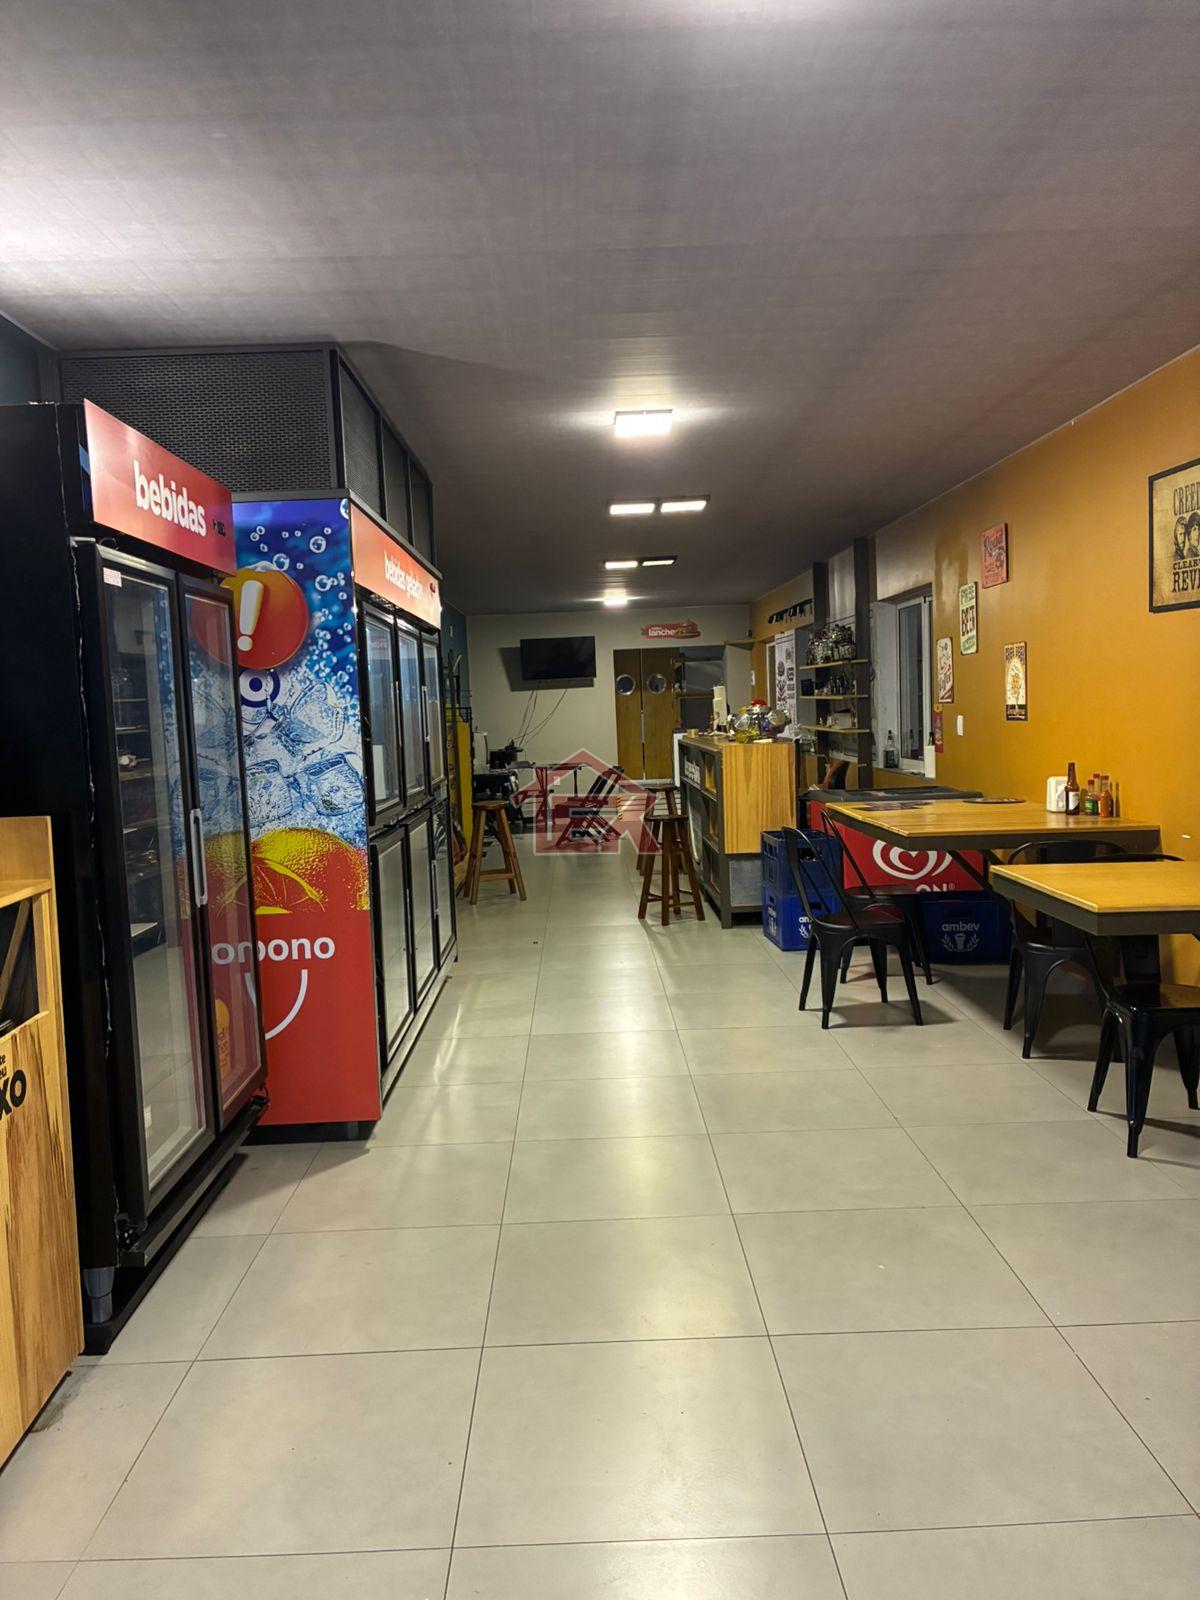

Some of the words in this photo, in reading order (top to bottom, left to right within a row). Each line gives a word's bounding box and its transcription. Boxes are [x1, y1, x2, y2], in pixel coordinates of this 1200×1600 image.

[133, 458, 207, 537] bebidas
[1173, 557, 1200, 571] CLEAR
[941, 921, 980, 932] ambev
